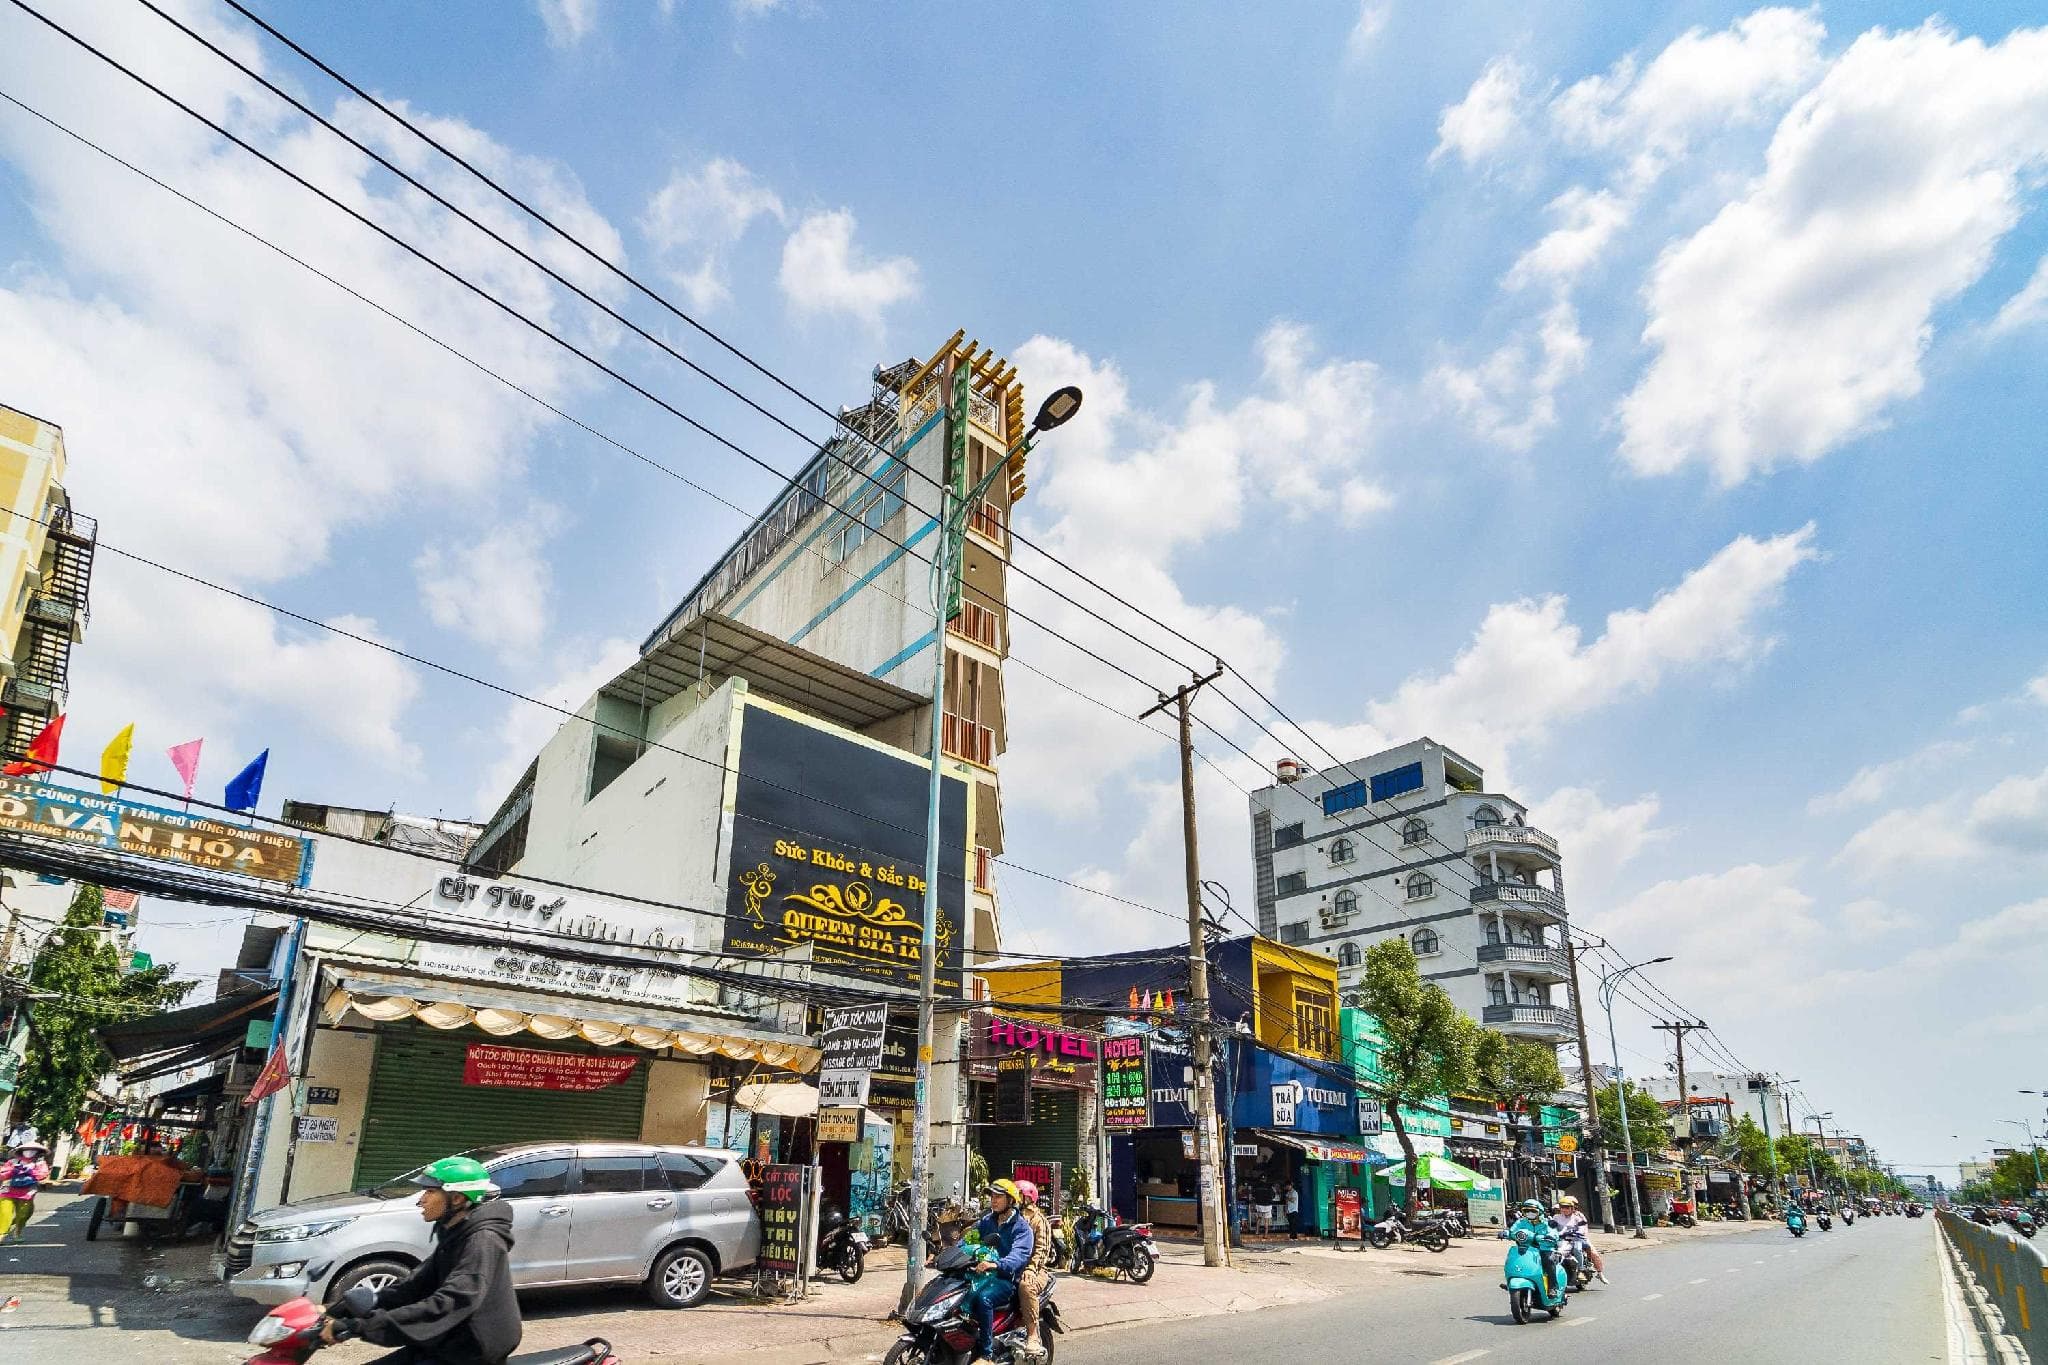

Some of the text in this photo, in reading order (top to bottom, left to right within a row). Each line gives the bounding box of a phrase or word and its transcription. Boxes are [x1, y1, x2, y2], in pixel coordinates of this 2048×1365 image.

[50, 806, 154, 843] VĂN
[170, 832, 265, 866] HÓA
[227, 828, 261, 843] DANH
[264, 836, 294, 850] HIỆU
[775, 840, 927, 896] Sức Khỏe & Sắc Đẹ
[782, 909, 857, 946] QUEEN
[858, 926, 895, 954] SPA
[992, 1019, 1097, 1059] HOTEL
[1104, 1039, 1144, 1059] HOTEL
[1015, 1166, 1051, 1185] HOTEL
